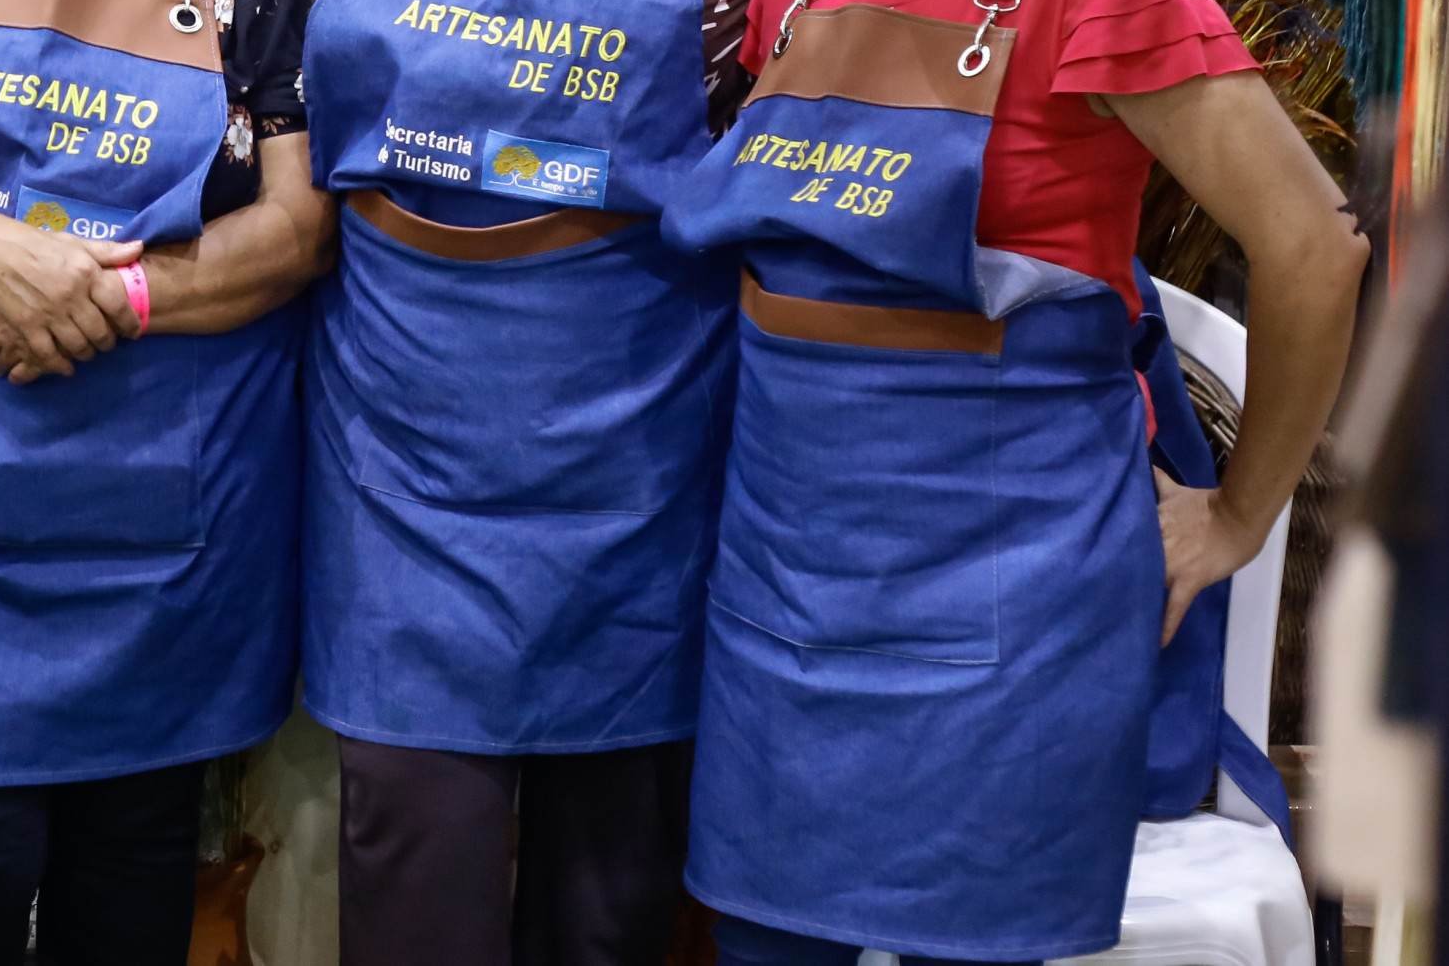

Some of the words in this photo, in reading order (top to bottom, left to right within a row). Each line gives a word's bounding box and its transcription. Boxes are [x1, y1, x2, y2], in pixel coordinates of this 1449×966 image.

[394, 0, 627, 62] ARTESANATO
[508, 60, 553, 93] DE
[563, 66, 620, 102] BSB
[46, 121, 89, 154] DE
[96, 132, 152, 166] BSB
[734, 134, 912, 181] ARTESANATO
[394, 149, 471, 181] Turismo
[544, 160, 600, 187] GDF
[790, 178, 833, 203] DE
[835, 182, 894, 218] BSB
